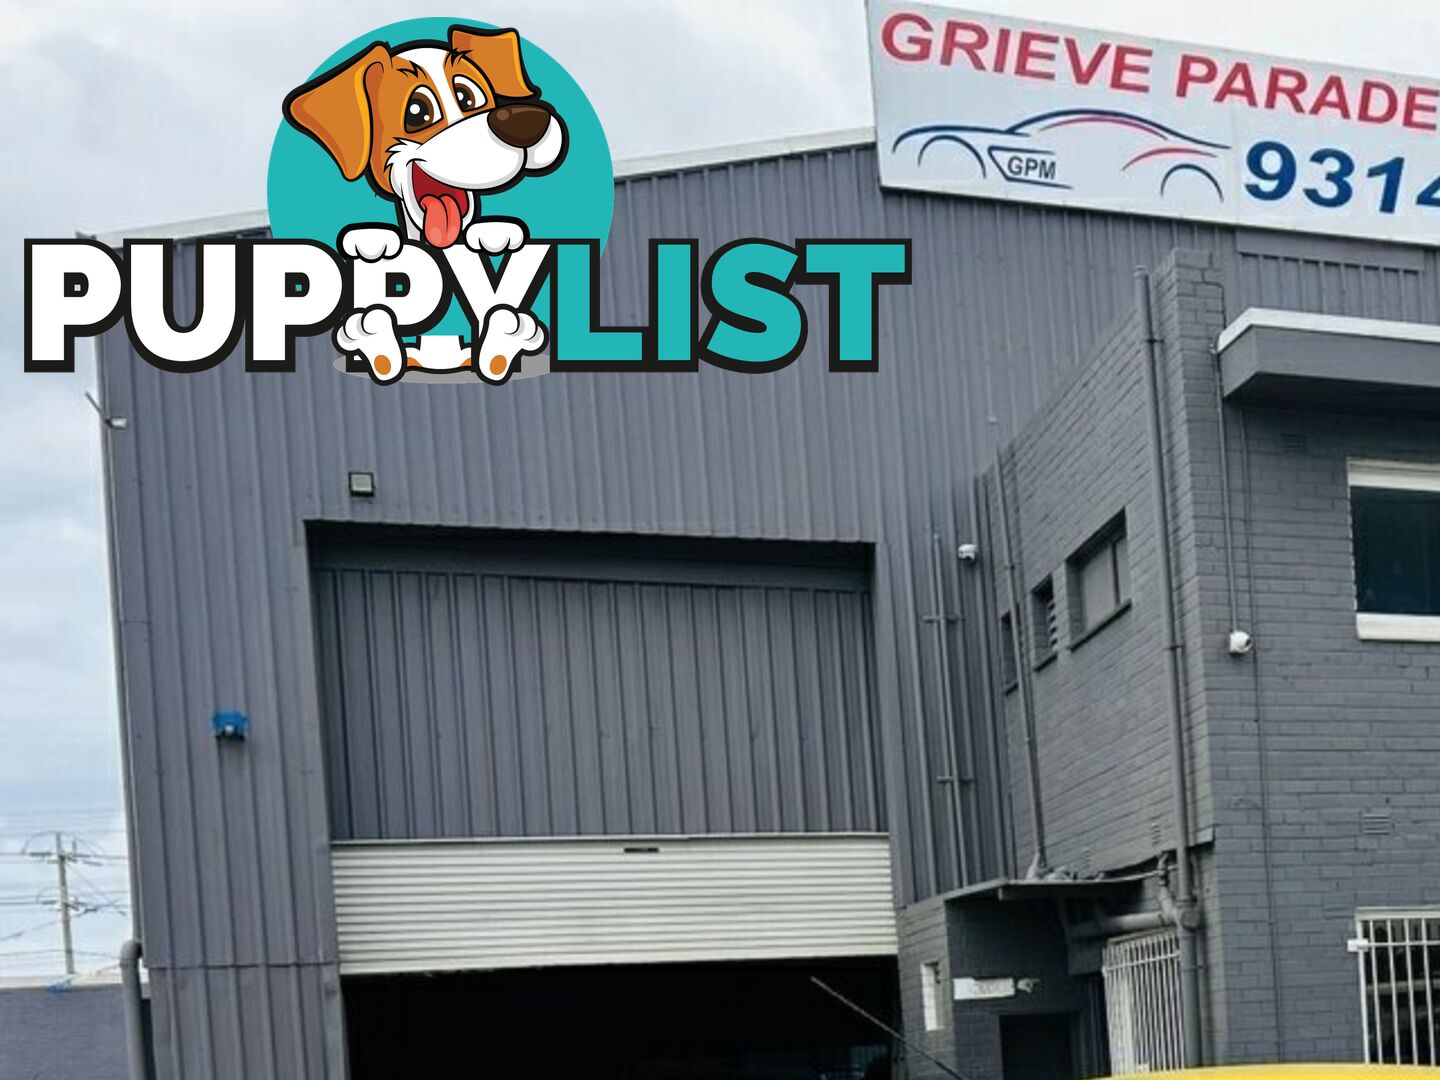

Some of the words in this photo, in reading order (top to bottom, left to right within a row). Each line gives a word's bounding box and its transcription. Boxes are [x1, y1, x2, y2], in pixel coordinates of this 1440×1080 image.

[880, 11, 1152, 93] GRIEVE
[1174, 53, 1440, 131] PARADE
[1007, 155, 1056, 180] GPM
